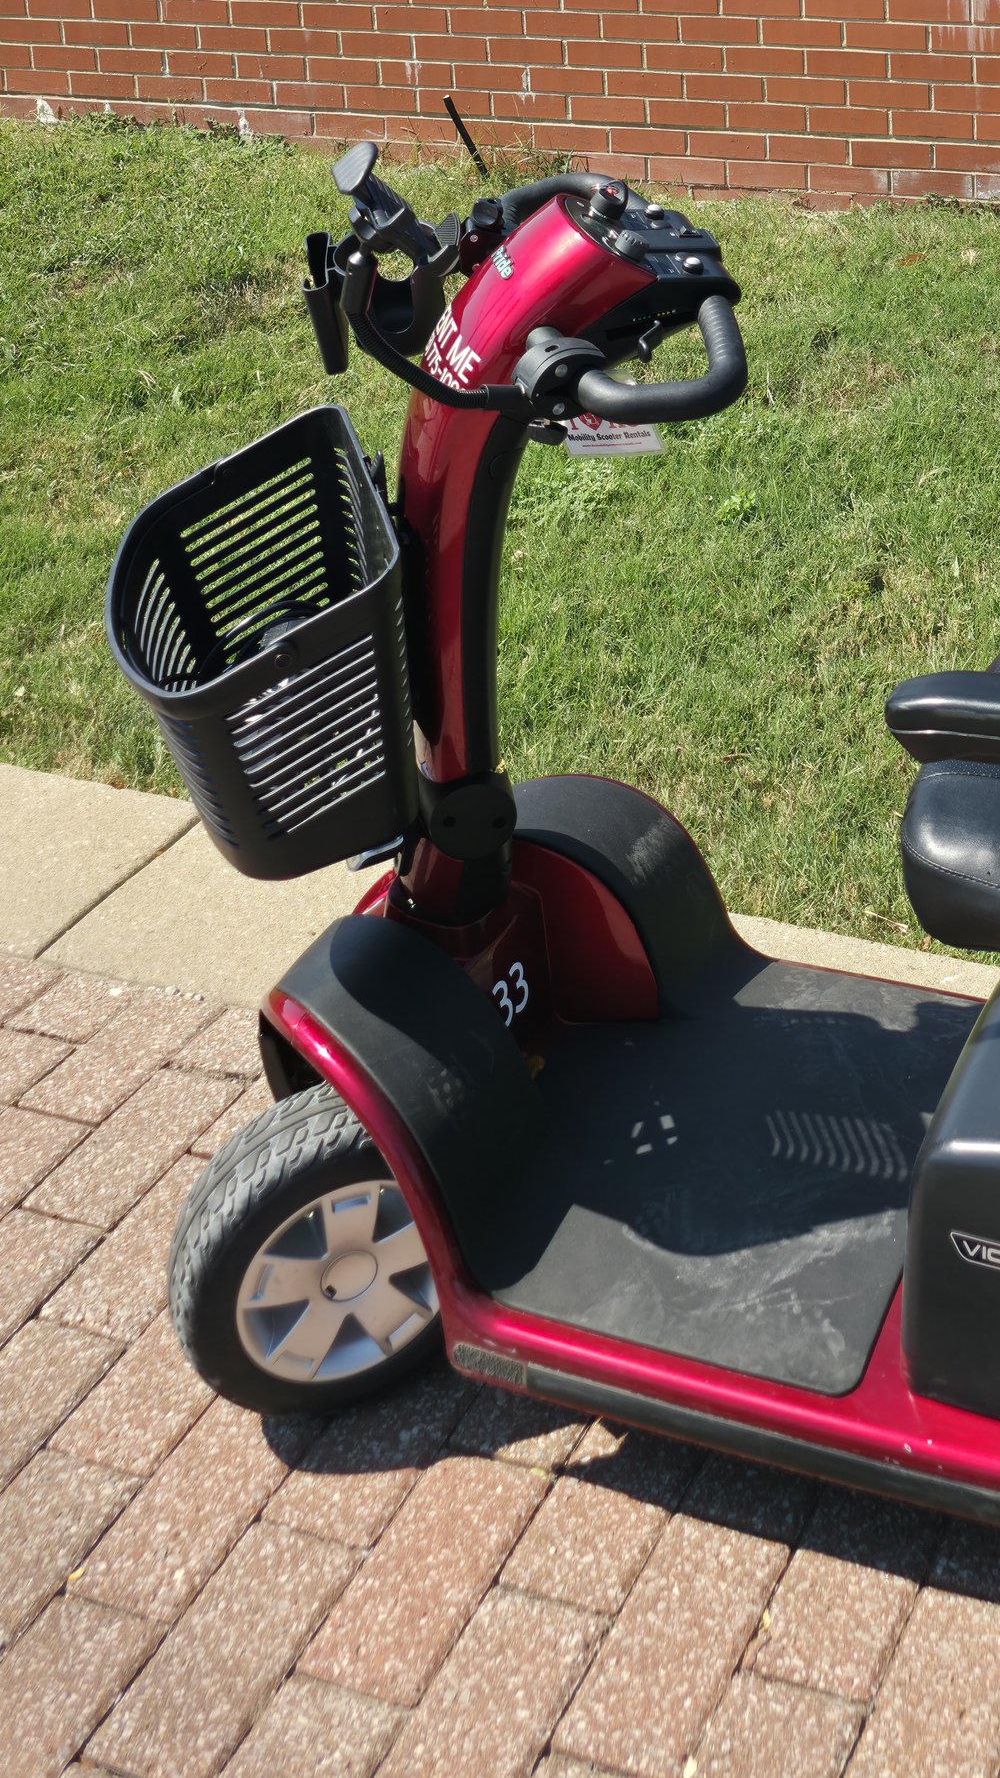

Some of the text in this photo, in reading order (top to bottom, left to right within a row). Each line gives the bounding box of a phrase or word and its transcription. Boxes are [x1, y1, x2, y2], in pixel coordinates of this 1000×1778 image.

[445, 333, 482, 384] ME
[568, 430, 652, 442] Mobility Scooter Rentals
[491, 961, 530, 1028] 33
